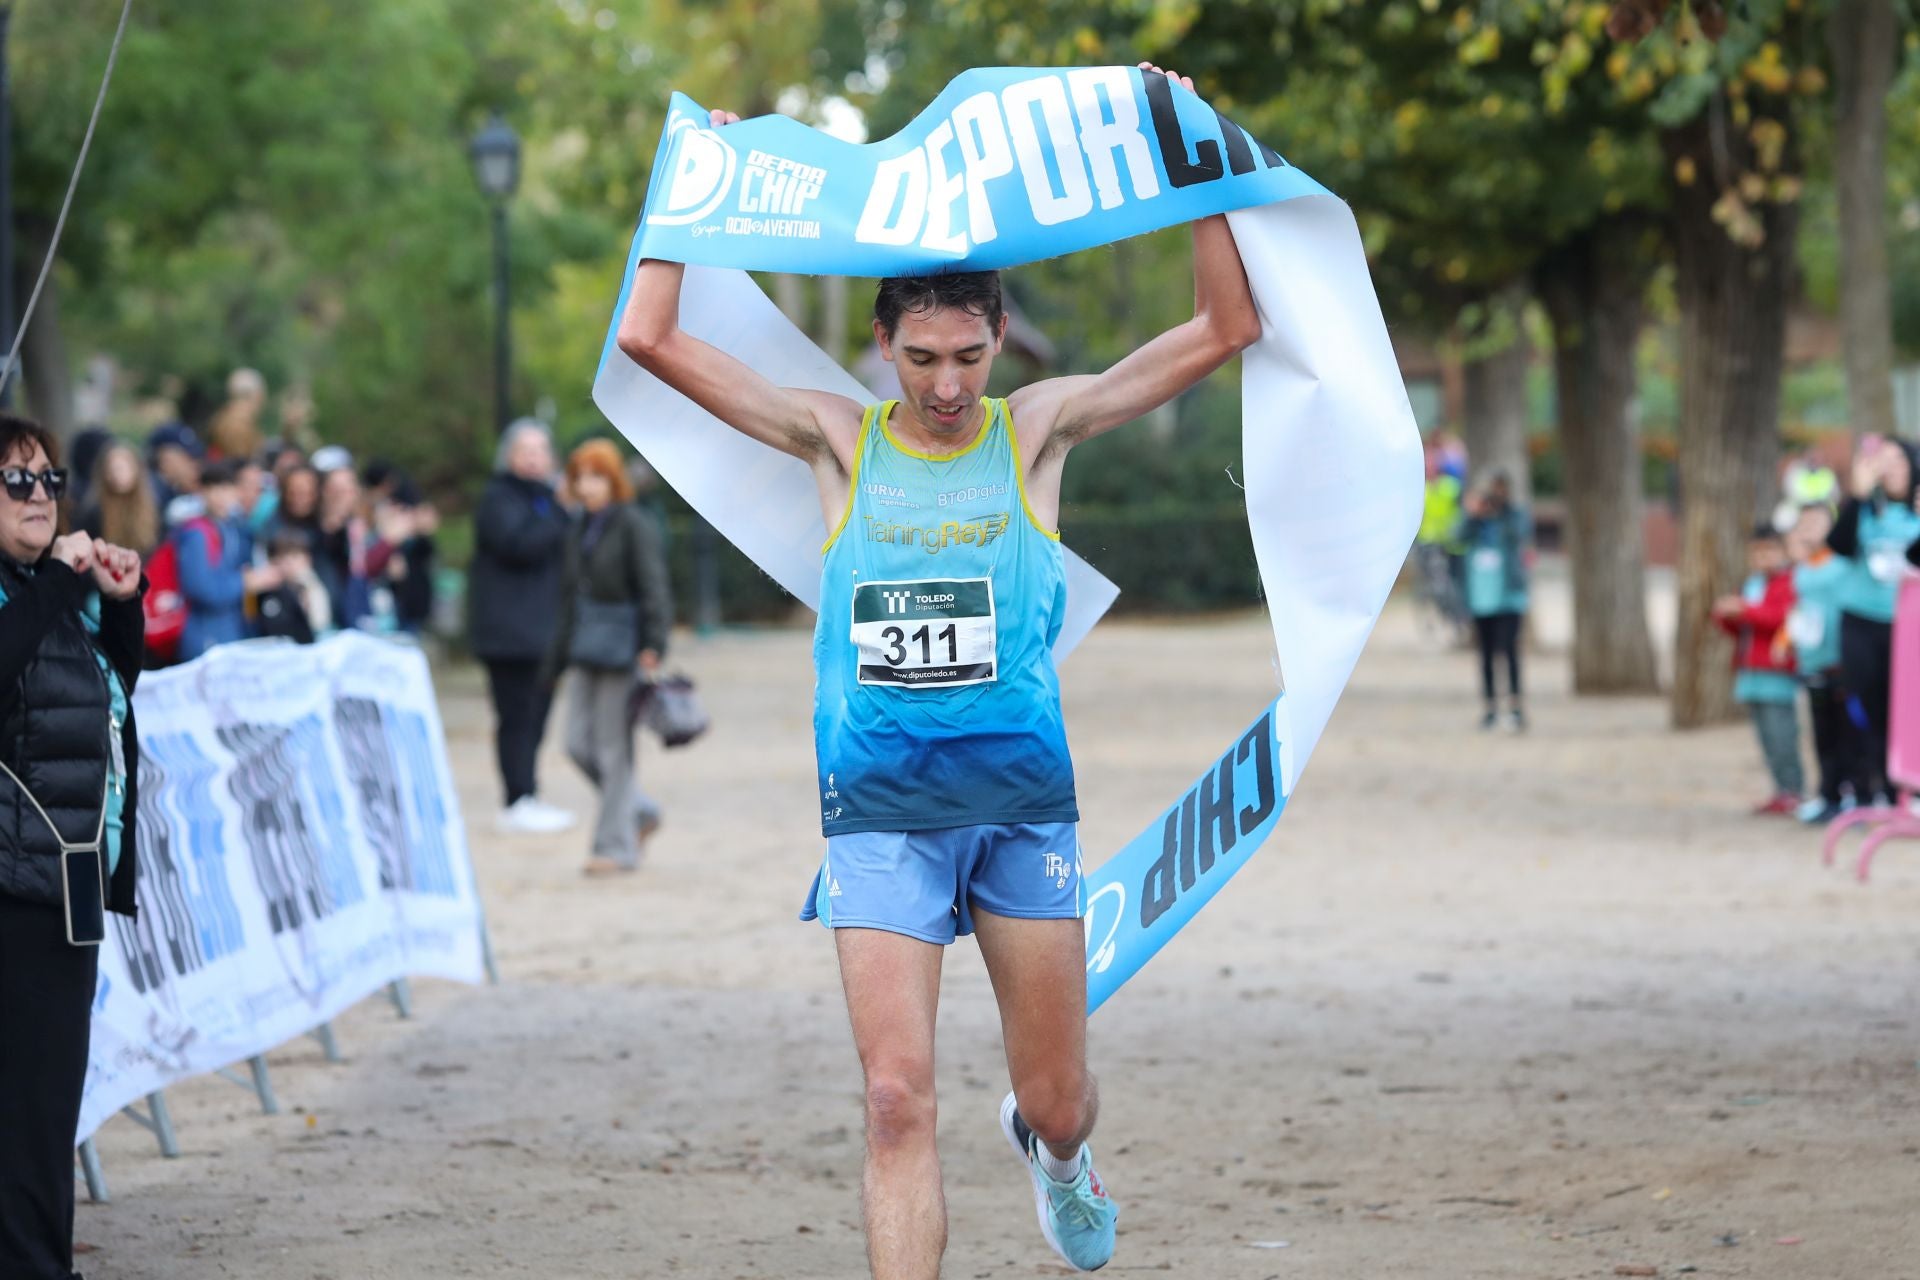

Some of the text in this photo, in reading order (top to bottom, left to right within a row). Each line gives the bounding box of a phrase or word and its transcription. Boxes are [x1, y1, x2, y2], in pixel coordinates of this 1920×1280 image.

[746, 149, 828, 185] DEPOR
[738, 165, 822, 215] CHIP
[936, 481, 1009, 507] BTODigital
[914, 593, 955, 604] TOLEDO
[915, 602, 955, 611] Diputación
[881, 623, 957, 666] 311
